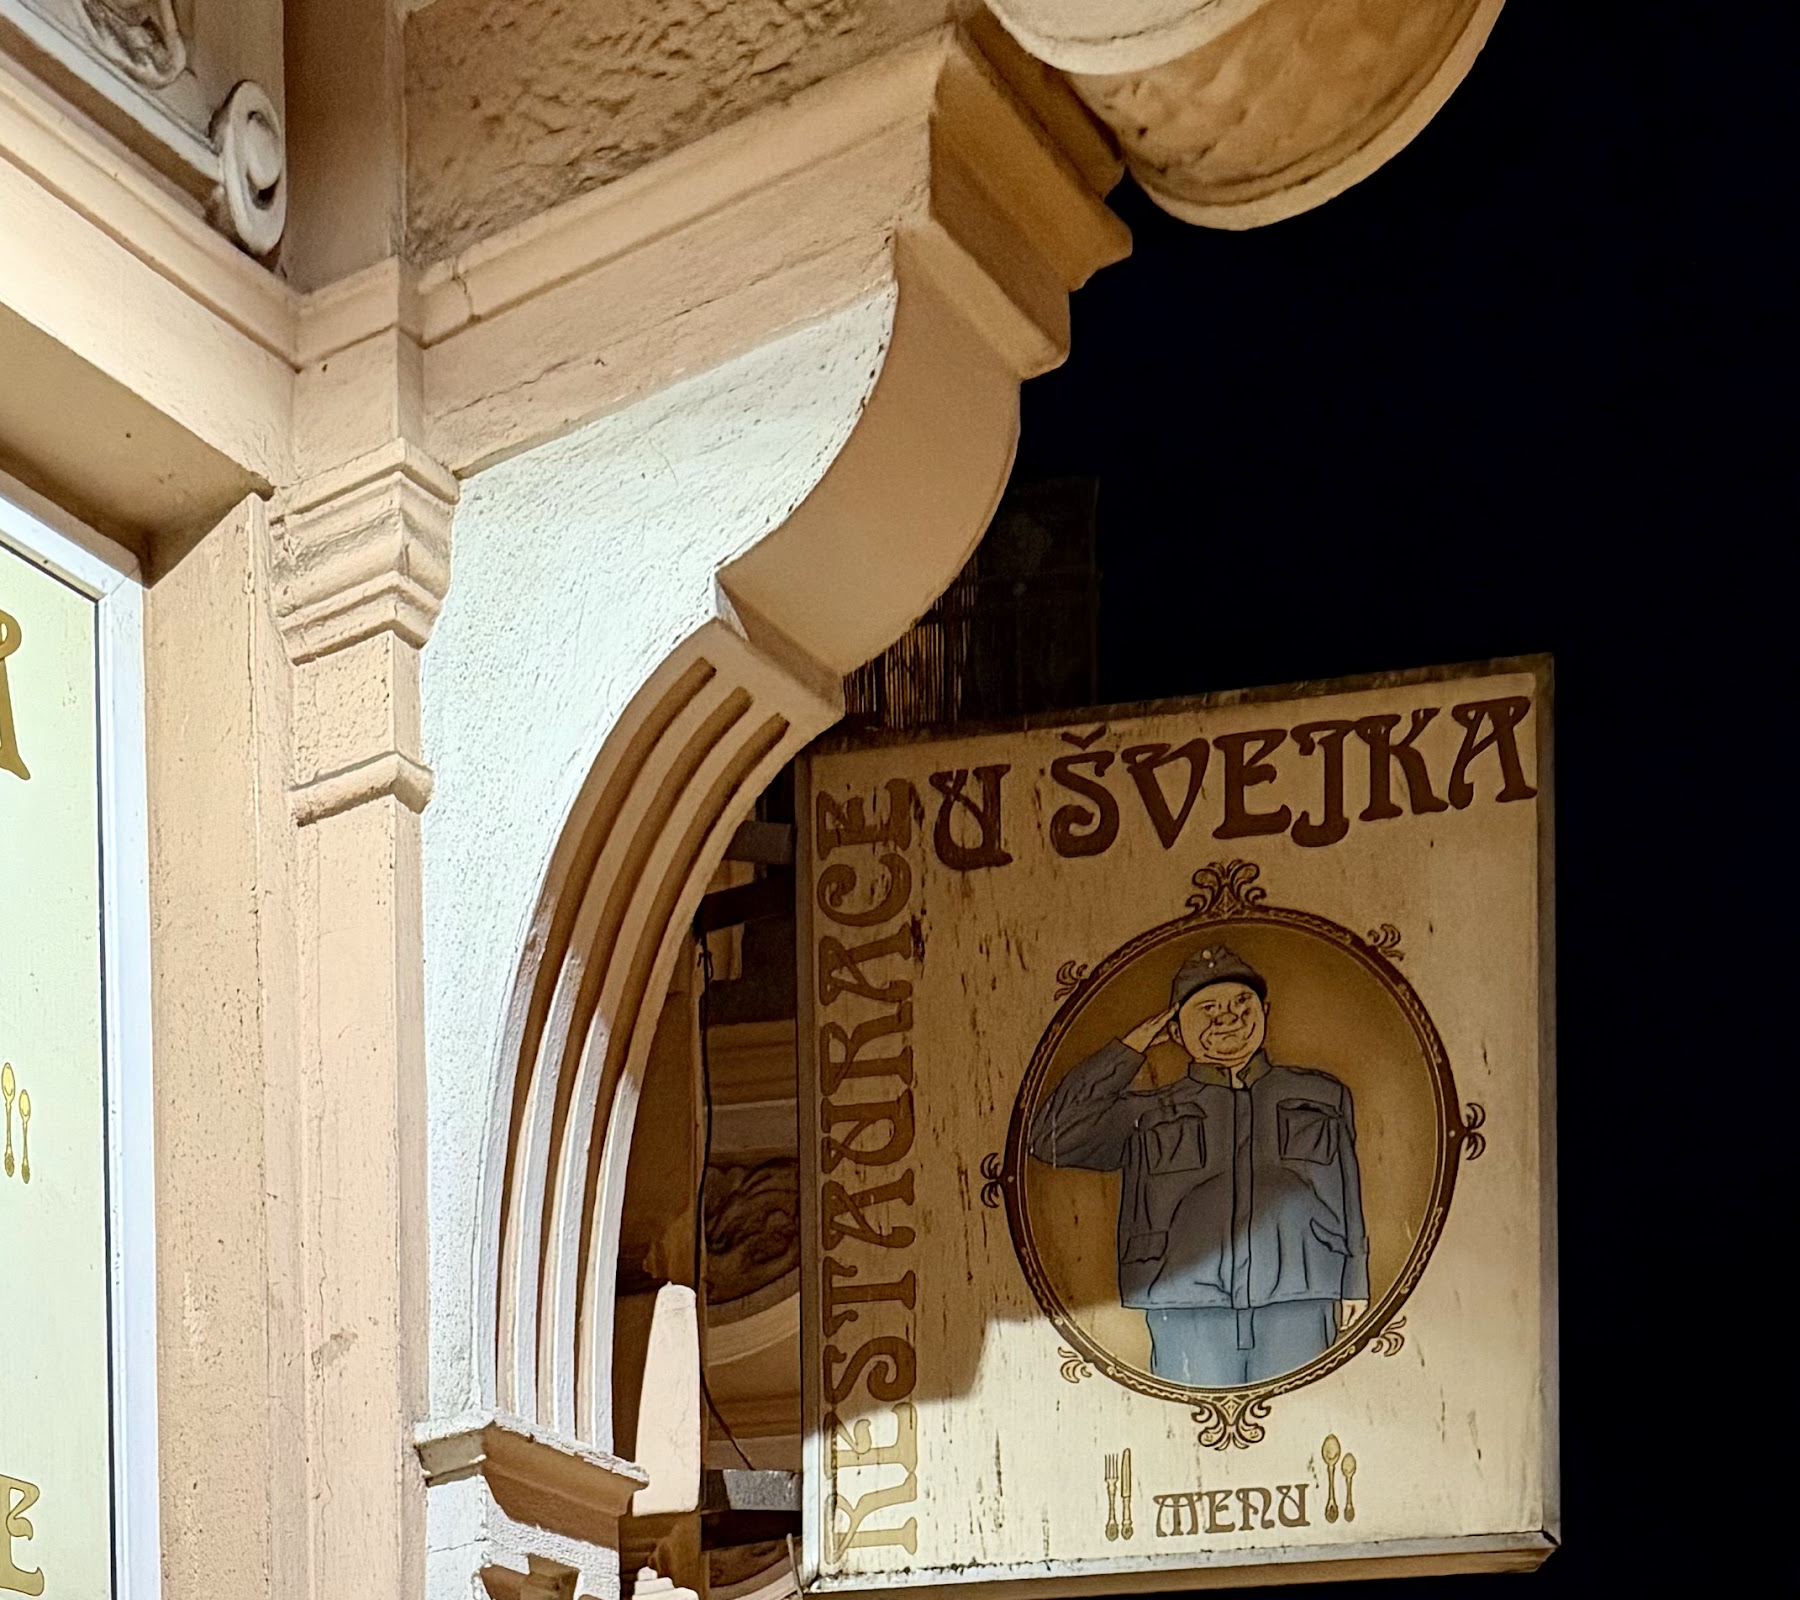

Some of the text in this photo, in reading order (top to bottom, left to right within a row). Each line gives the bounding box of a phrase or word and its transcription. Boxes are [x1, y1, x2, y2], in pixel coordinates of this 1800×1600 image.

[928, 694, 1539, 872] U ŠVEJKA
[814, 775, 919, 1565] RESTAURACE
[1153, 1479, 1312, 1539] MENU
